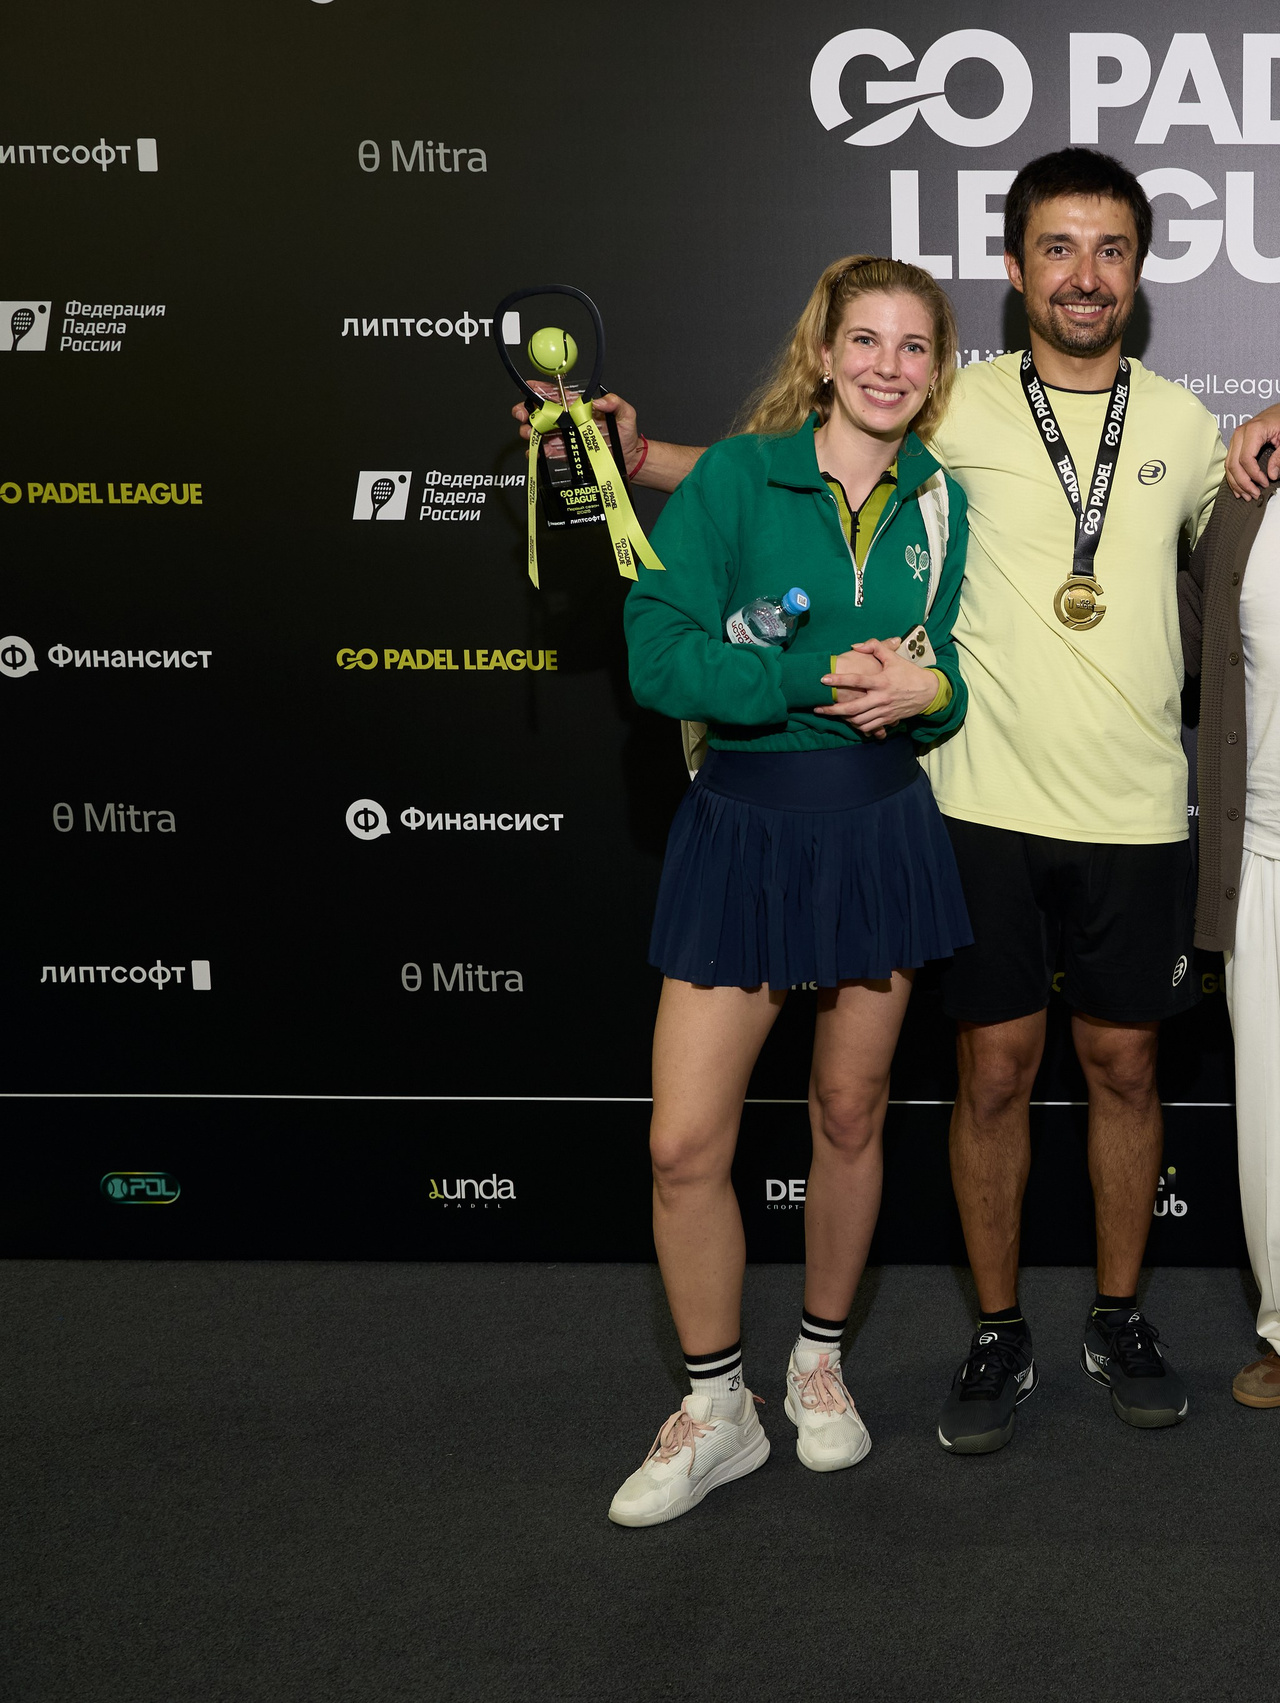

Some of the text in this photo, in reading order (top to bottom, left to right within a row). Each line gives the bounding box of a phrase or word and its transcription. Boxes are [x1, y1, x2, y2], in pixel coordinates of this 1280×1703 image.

[810, 29, 1033, 147] GO
[392, 141, 487, 172] Mitra
[65, 300, 165, 320] Федерация
[63, 318, 126, 336] Падела
[342, 312, 493, 344] липтсофт
[60, 334, 121, 351] России
[1028, 376, 1050, 418] PADEL
[1111, 383, 1129, 423] PADEL
[424, 471, 525, 491] Федерация
[1090, 461, 1113, 508] PADEL
[28, 482, 103, 503] PADEL
[108, 483, 202, 505] LEAGUE
[423, 488, 485, 505] Падела
[420, 504, 480, 521] России
[738, 622, 757, 645] СВЯТ
[48, 644, 212, 668] Финансист
[337, 648, 557, 670] GO PADEL LEAGUE
[84, 803, 176, 832] Mitra
[401, 807, 563, 831] Финансист
[41, 960, 185, 990] липтсофт
[433, 963, 523, 992] Mitra
